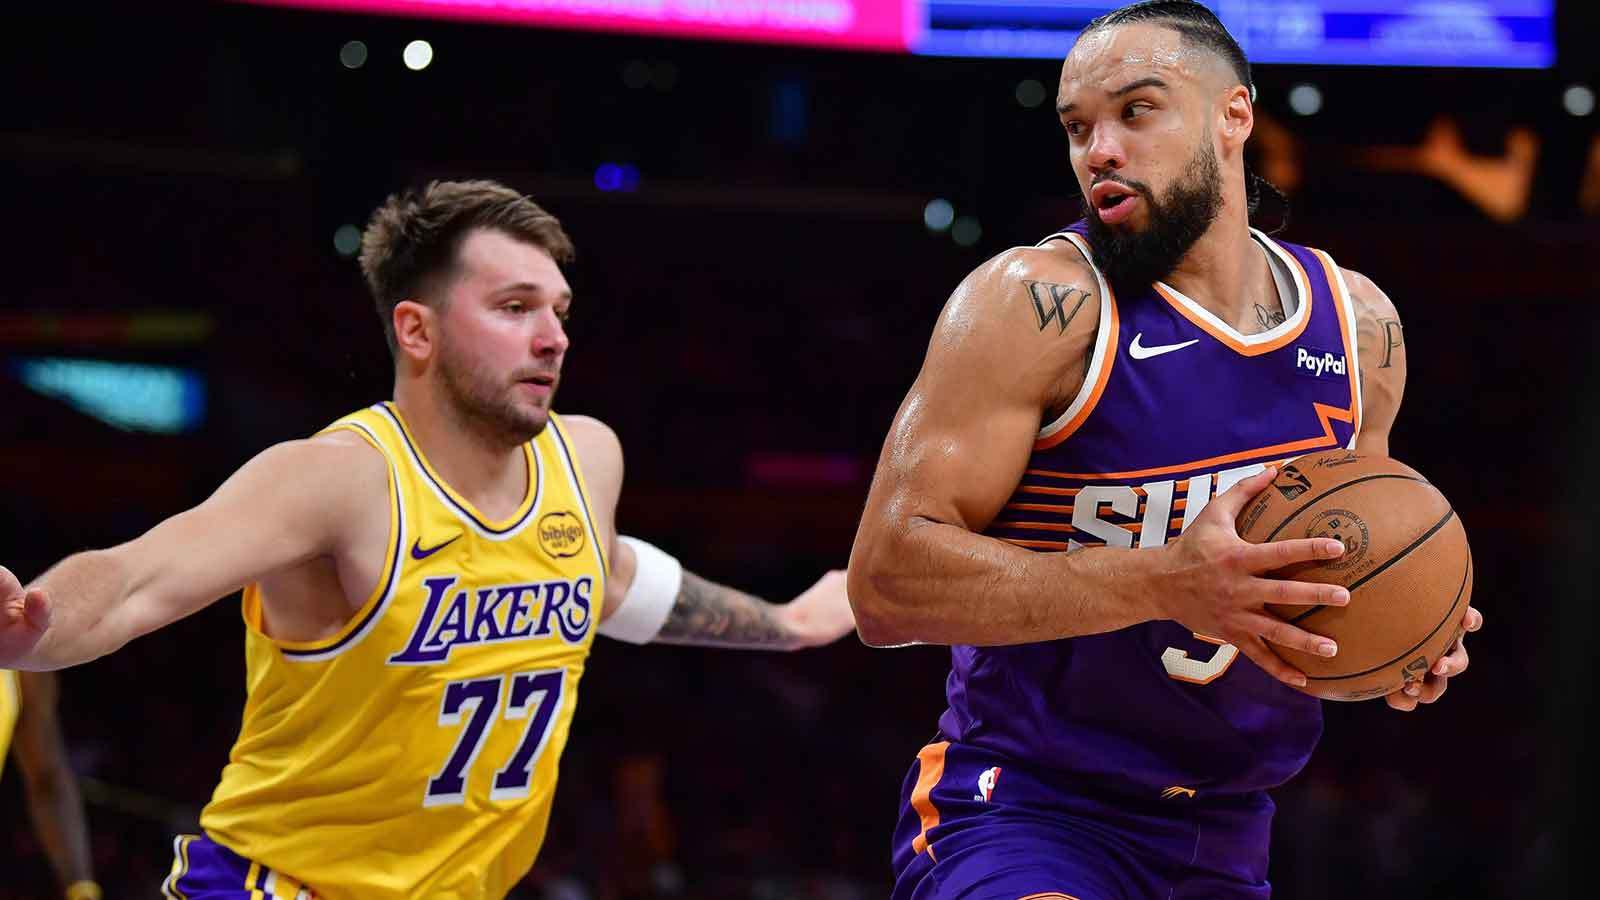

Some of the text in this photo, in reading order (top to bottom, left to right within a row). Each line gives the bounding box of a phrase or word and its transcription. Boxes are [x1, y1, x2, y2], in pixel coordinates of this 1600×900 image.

[1297, 347, 1346, 377] PayPal
[541, 523, 582, 544] bibigo
[385, 576, 592, 665] LAKERS
[423, 667, 567, 806] 77
